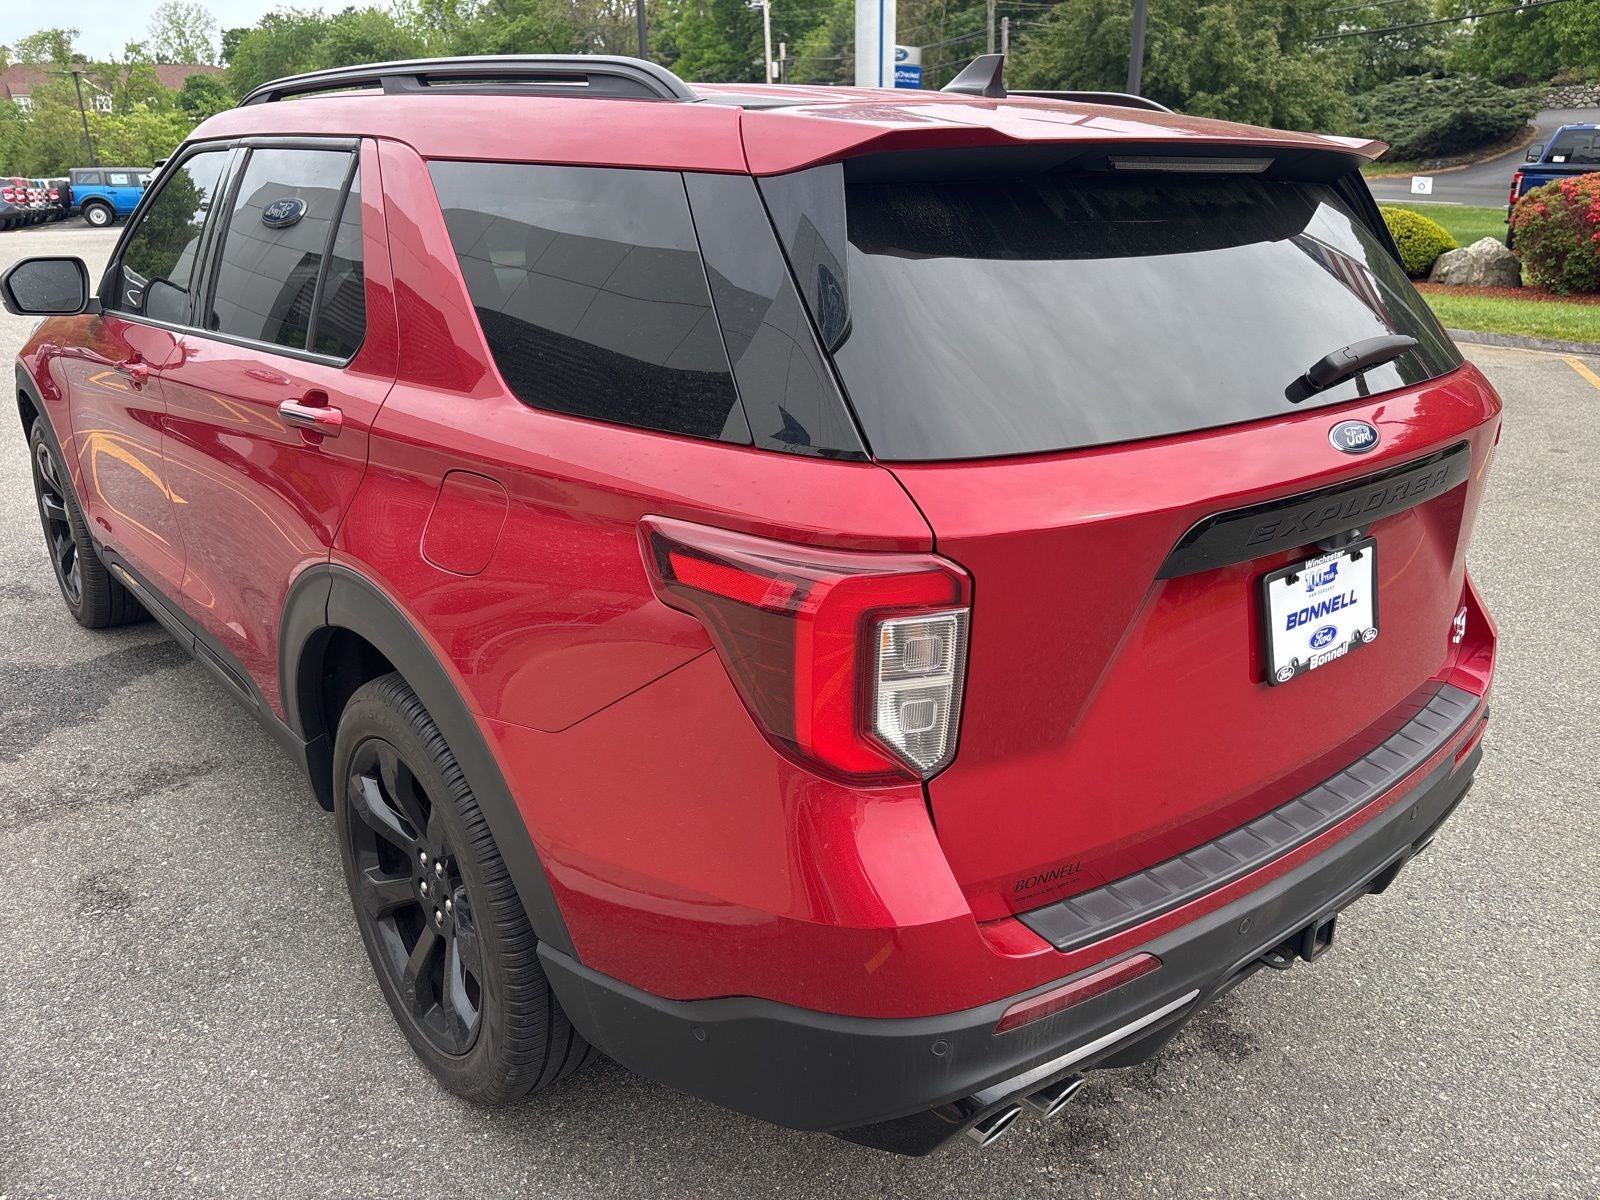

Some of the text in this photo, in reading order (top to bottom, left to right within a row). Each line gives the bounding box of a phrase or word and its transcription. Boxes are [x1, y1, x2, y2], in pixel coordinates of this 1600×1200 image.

[1344, 424, 1374, 447] Ford
[1248, 465, 1449, 547] EXPLORER
[1305, 550, 1346, 570] Winchester
[1305, 569, 1325, 591] 100
[1286, 589, 1358, 632] BONNELL
[1313, 627, 1334, 647] Ford
[1363, 629, 1376, 642] Ford
[1310, 641, 1349, 670] Bonnell
[1278, 667, 1293, 681] Ford
[1014, 860, 1082, 893] BONNELL
